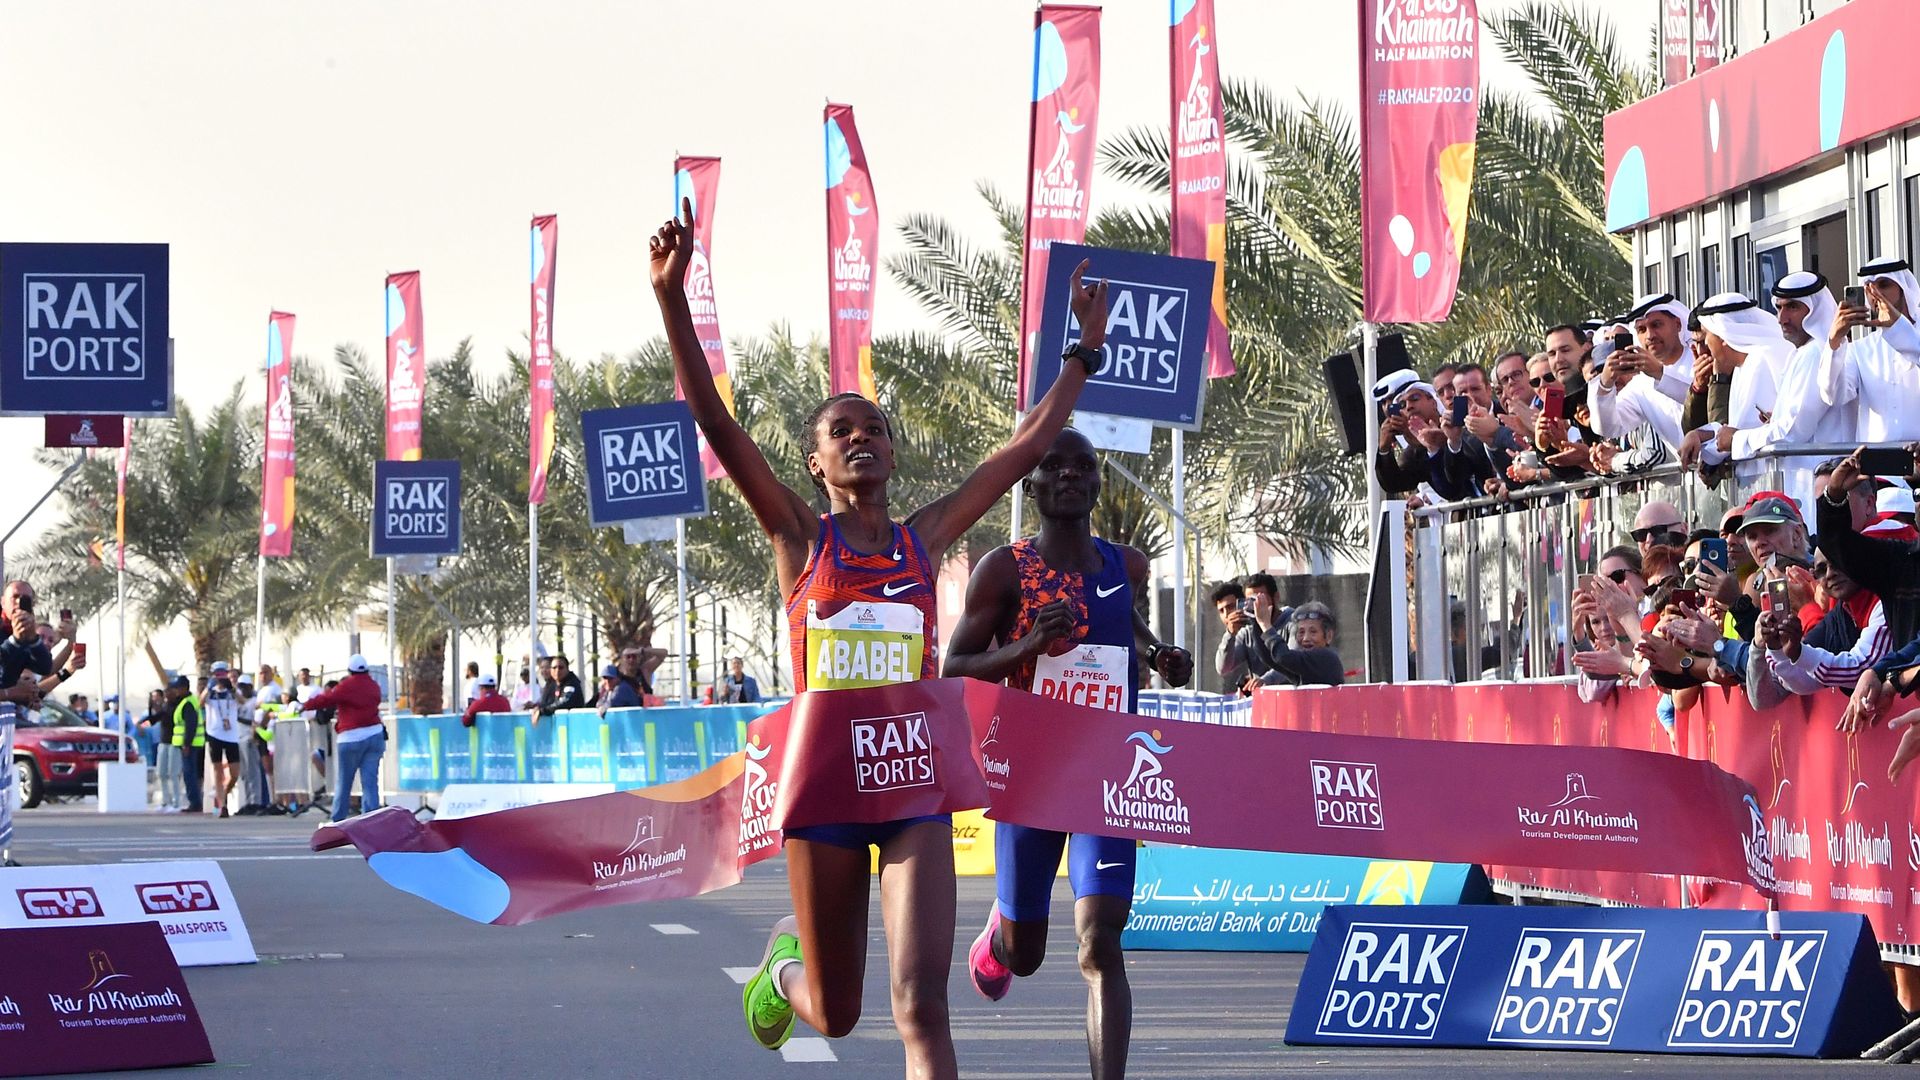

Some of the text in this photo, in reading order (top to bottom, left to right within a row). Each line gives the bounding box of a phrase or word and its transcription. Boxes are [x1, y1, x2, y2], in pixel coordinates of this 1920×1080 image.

[1375, 0, 1474, 45] Khaimah
[1375, 45, 1473, 62] HALF MARATHON
[1378, 86, 1473, 105] #RAKHALF2020
[28, 281, 139, 330] RAK
[1071, 289, 1181, 342] AK
[28, 336, 141, 373] PORTS
[1068, 338, 1177, 385] ORTS
[603, 428, 679, 467] RAK
[387, 482, 445, 509] RAK
[606, 465, 684, 496] PORTS
[387, 512, 446, 534] PORTS
[815, 638, 913, 682] ABABEL
[1063, 669, 1074, 678] 83
[1081, 671, 1109, 681] PYEGO
[854, 718, 928, 758] RAK
[858, 755, 931, 786] PORTS
[1121, 744, 1174, 802] Ras
[1313, 765, 1377, 798] RAK
[1103, 779, 1189, 823] Khaimah
[1127, 781, 1139, 799] al
[1105, 816, 1191, 835] HALF MARATHON
[1317, 799, 1381, 825] PORTS
[1517, 806, 1638, 831] Ras Al Khaimah
[952, 825, 980, 838] ertz
[1521, 830, 1638, 844] Tourism Development Authority
[1825, 818, 1844, 868] Ras
[1855, 820, 1893, 871] Khaimah
[593, 843, 686, 879] Ras Al Khaimah
[1233, 883, 1286, 907] دبي
[1290, 879, 1350, 907] بنك
[188, 921, 228, 934] SPORTS
[1219, 911, 1264, 933] Bank
[1267, 911, 1289, 933] of
[1288, 911, 1322, 934] Dub
[1336, 931, 1459, 985] RAK
[1509, 936, 1636, 990] RAK
[1689, 939, 1818, 992] RAK
[48, 986, 182, 1014] Ras Al Khaimah
[1323, 990, 1441, 1031] PORTS
[1494, 996, 1617, 1036] PORTS
[59, 1013, 187, 1028] Tourism Development Authority
[1674, 999, 1801, 1039] PORTS
